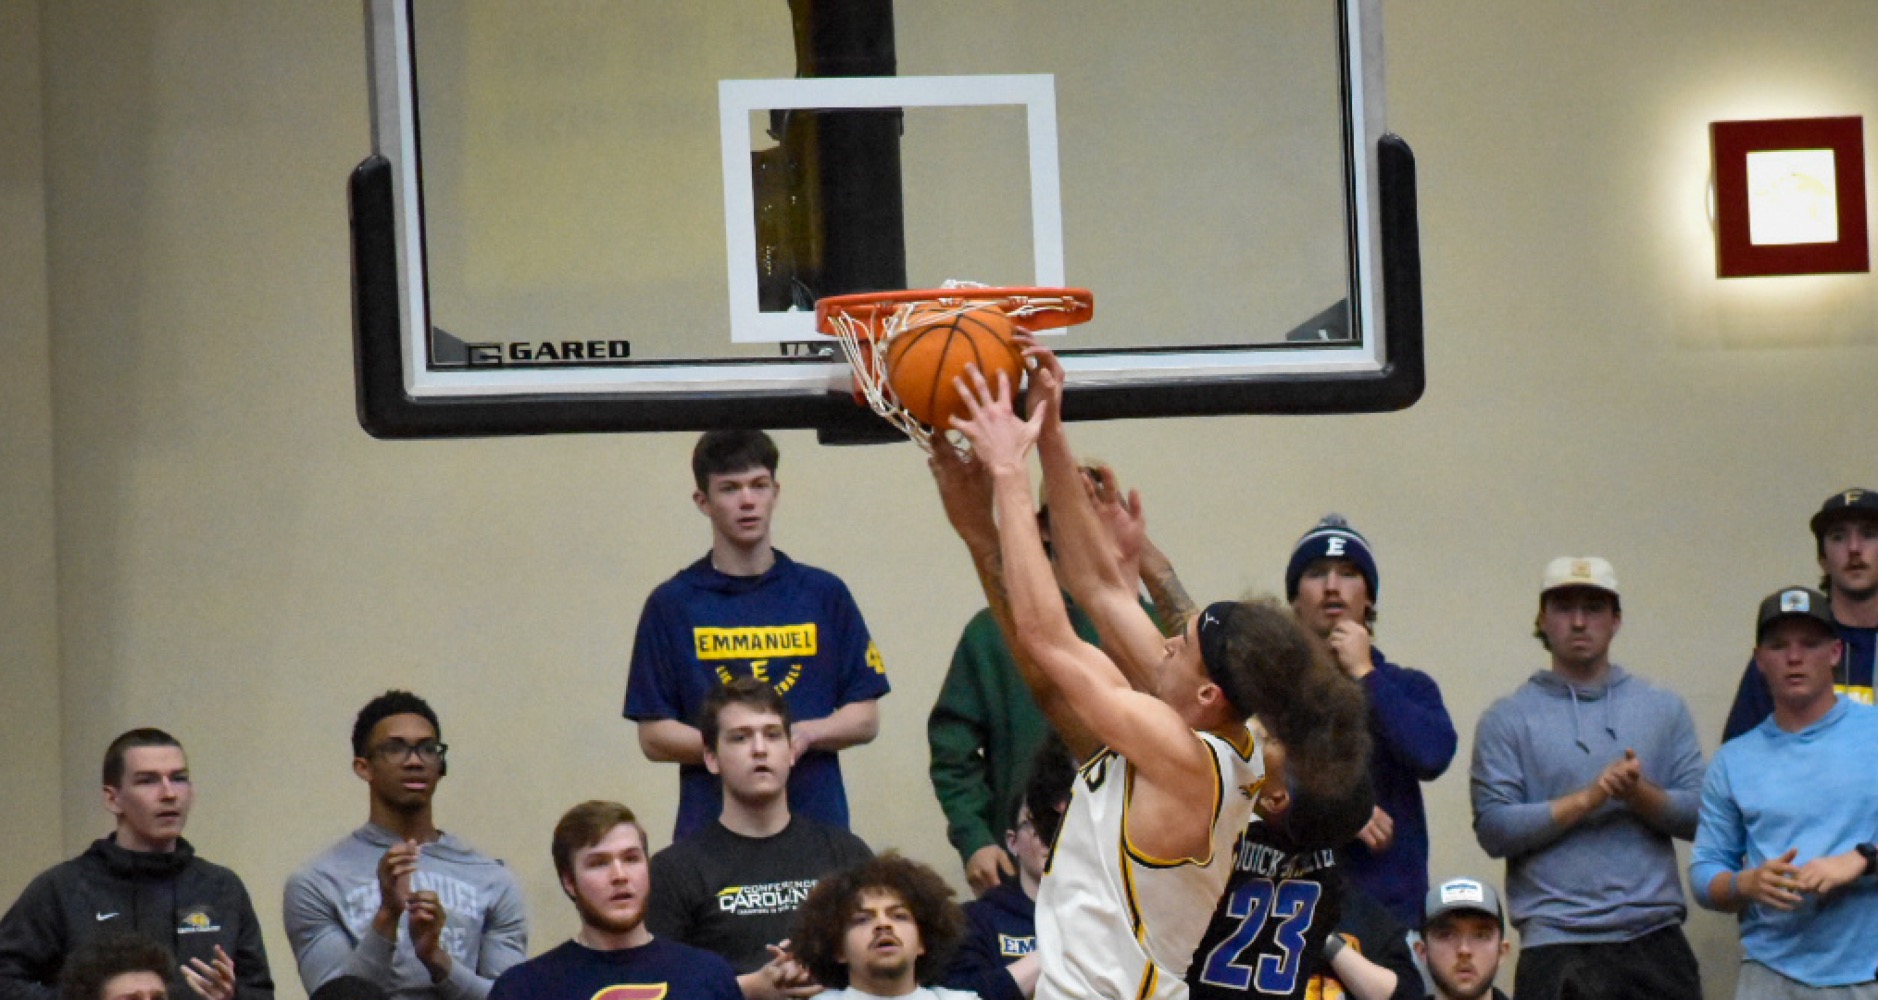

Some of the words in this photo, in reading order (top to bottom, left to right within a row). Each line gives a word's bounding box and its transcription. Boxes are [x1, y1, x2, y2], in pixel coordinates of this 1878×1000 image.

[509, 340, 630, 360] GARED
[1326, 537, 1347, 556] E
[699, 631, 811, 652] EMMANUEL
[751, 659, 771, 682] E
[1200, 877, 1322, 995] 23
